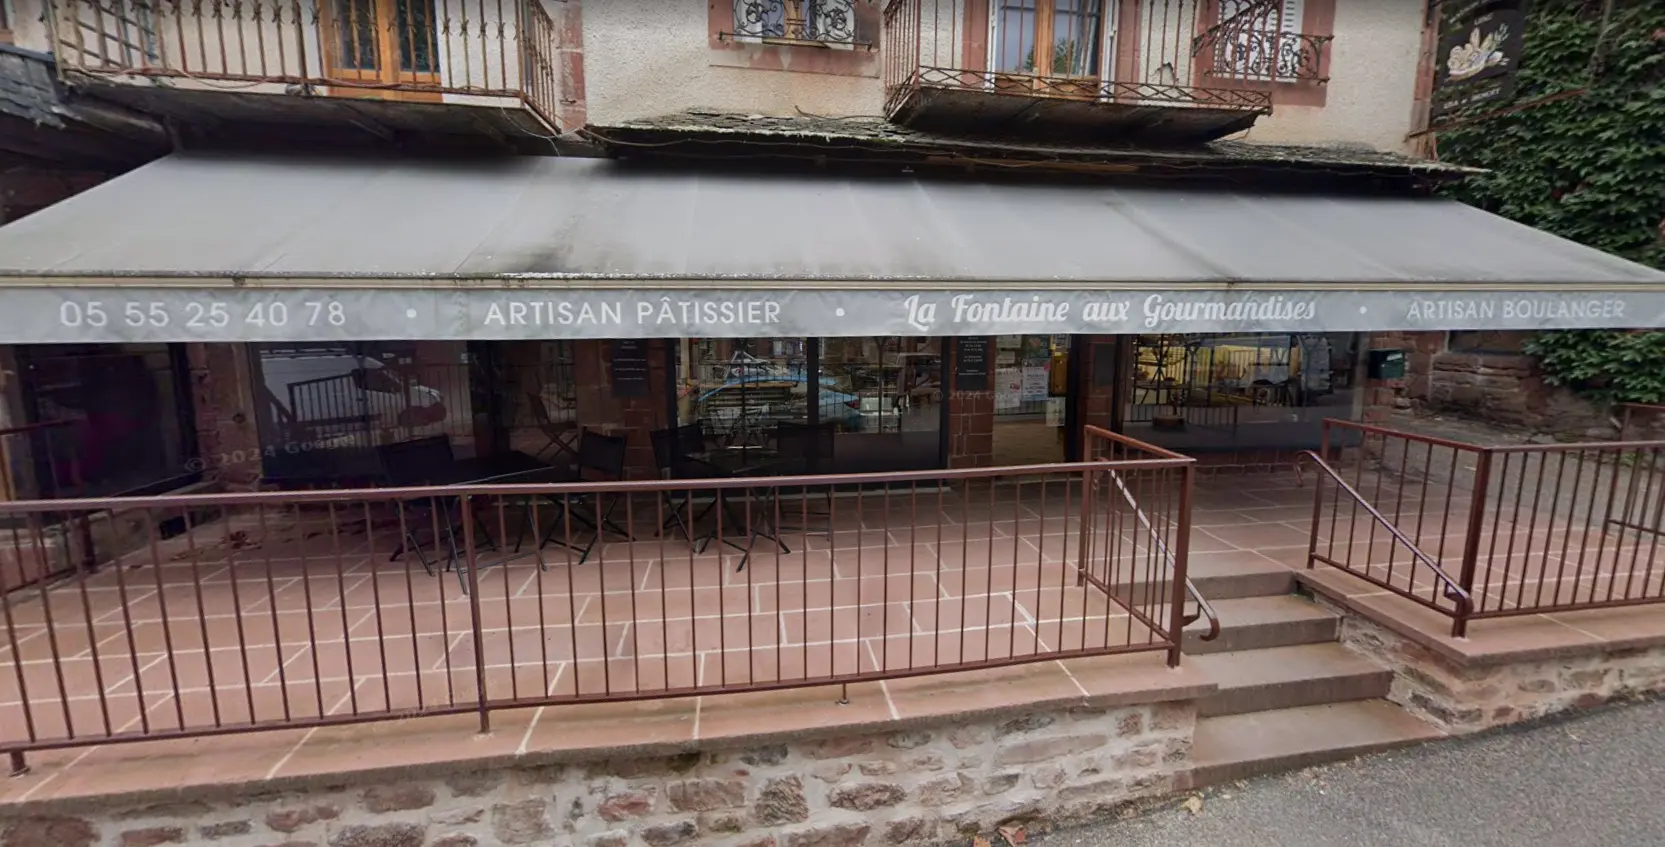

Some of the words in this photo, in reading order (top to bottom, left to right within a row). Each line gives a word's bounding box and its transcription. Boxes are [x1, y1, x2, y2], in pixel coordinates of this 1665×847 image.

[60, 301, 107, 327] 05
[125, 302, 170, 327] 55
[185, 302, 230, 327] 25
[245, 302, 288, 327] 40
[305, 301, 346, 326] 78
[485, 301, 622, 326] ARTISAN
[637, 297, 781, 325] PÂTISSIER
[904, 294, 937, 331] La
[951, 294, 1070, 323] Fontaine
[1082, 301, 1131, 322] aux
[1143, 294, 1316, 328] Gourmandises
[1407, 299, 1494, 319] ARTISAN
[1504, 300, 1626, 319] BOULANGER
